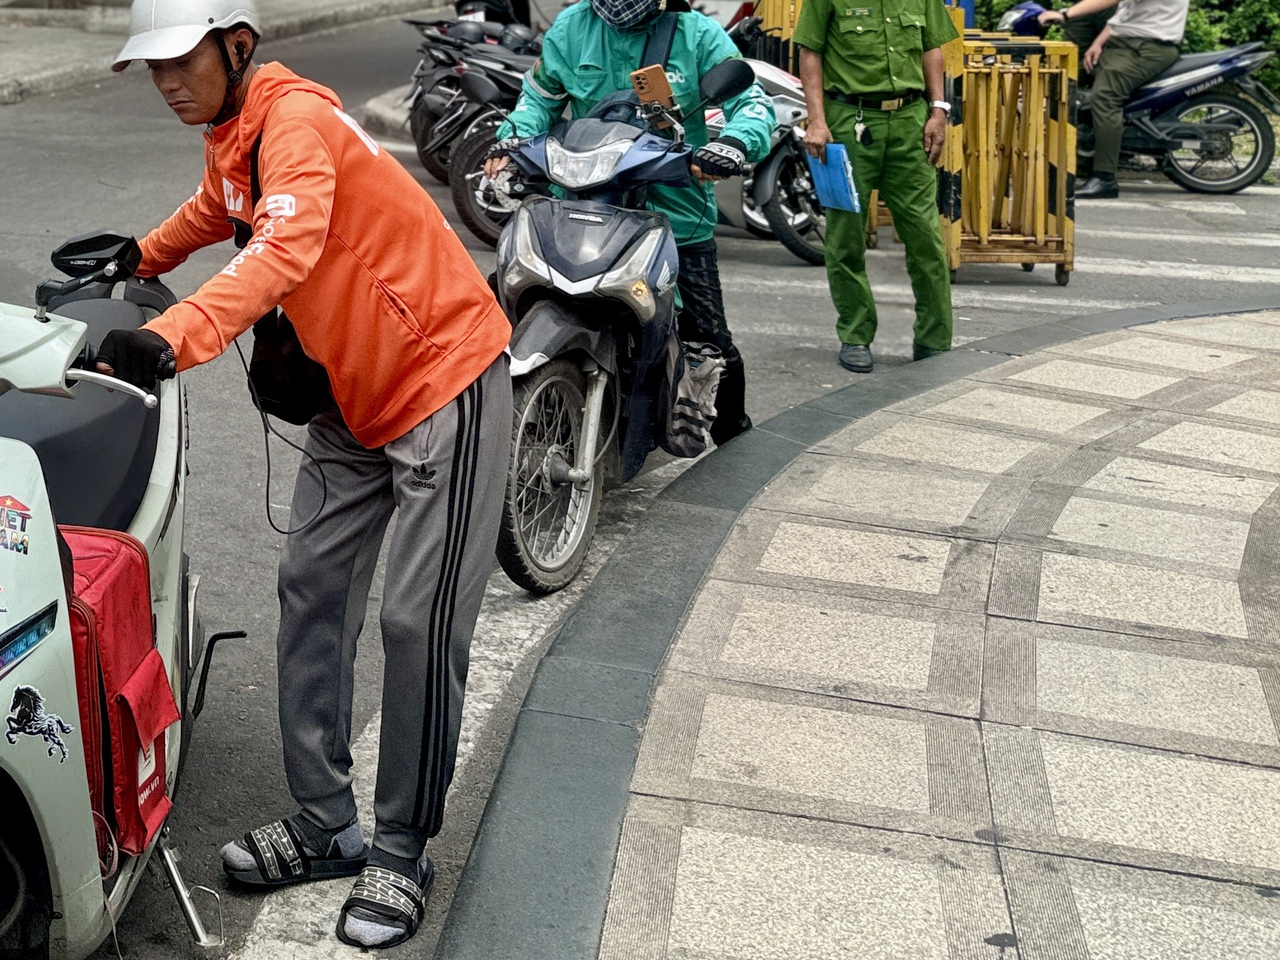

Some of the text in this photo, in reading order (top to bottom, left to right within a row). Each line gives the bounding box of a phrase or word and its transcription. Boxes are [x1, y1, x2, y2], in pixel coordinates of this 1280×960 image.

[1185, 76, 1224, 96] YAMAHA
[568, 213, 604, 223] HONDA
[410, 480, 436, 490] adidas
